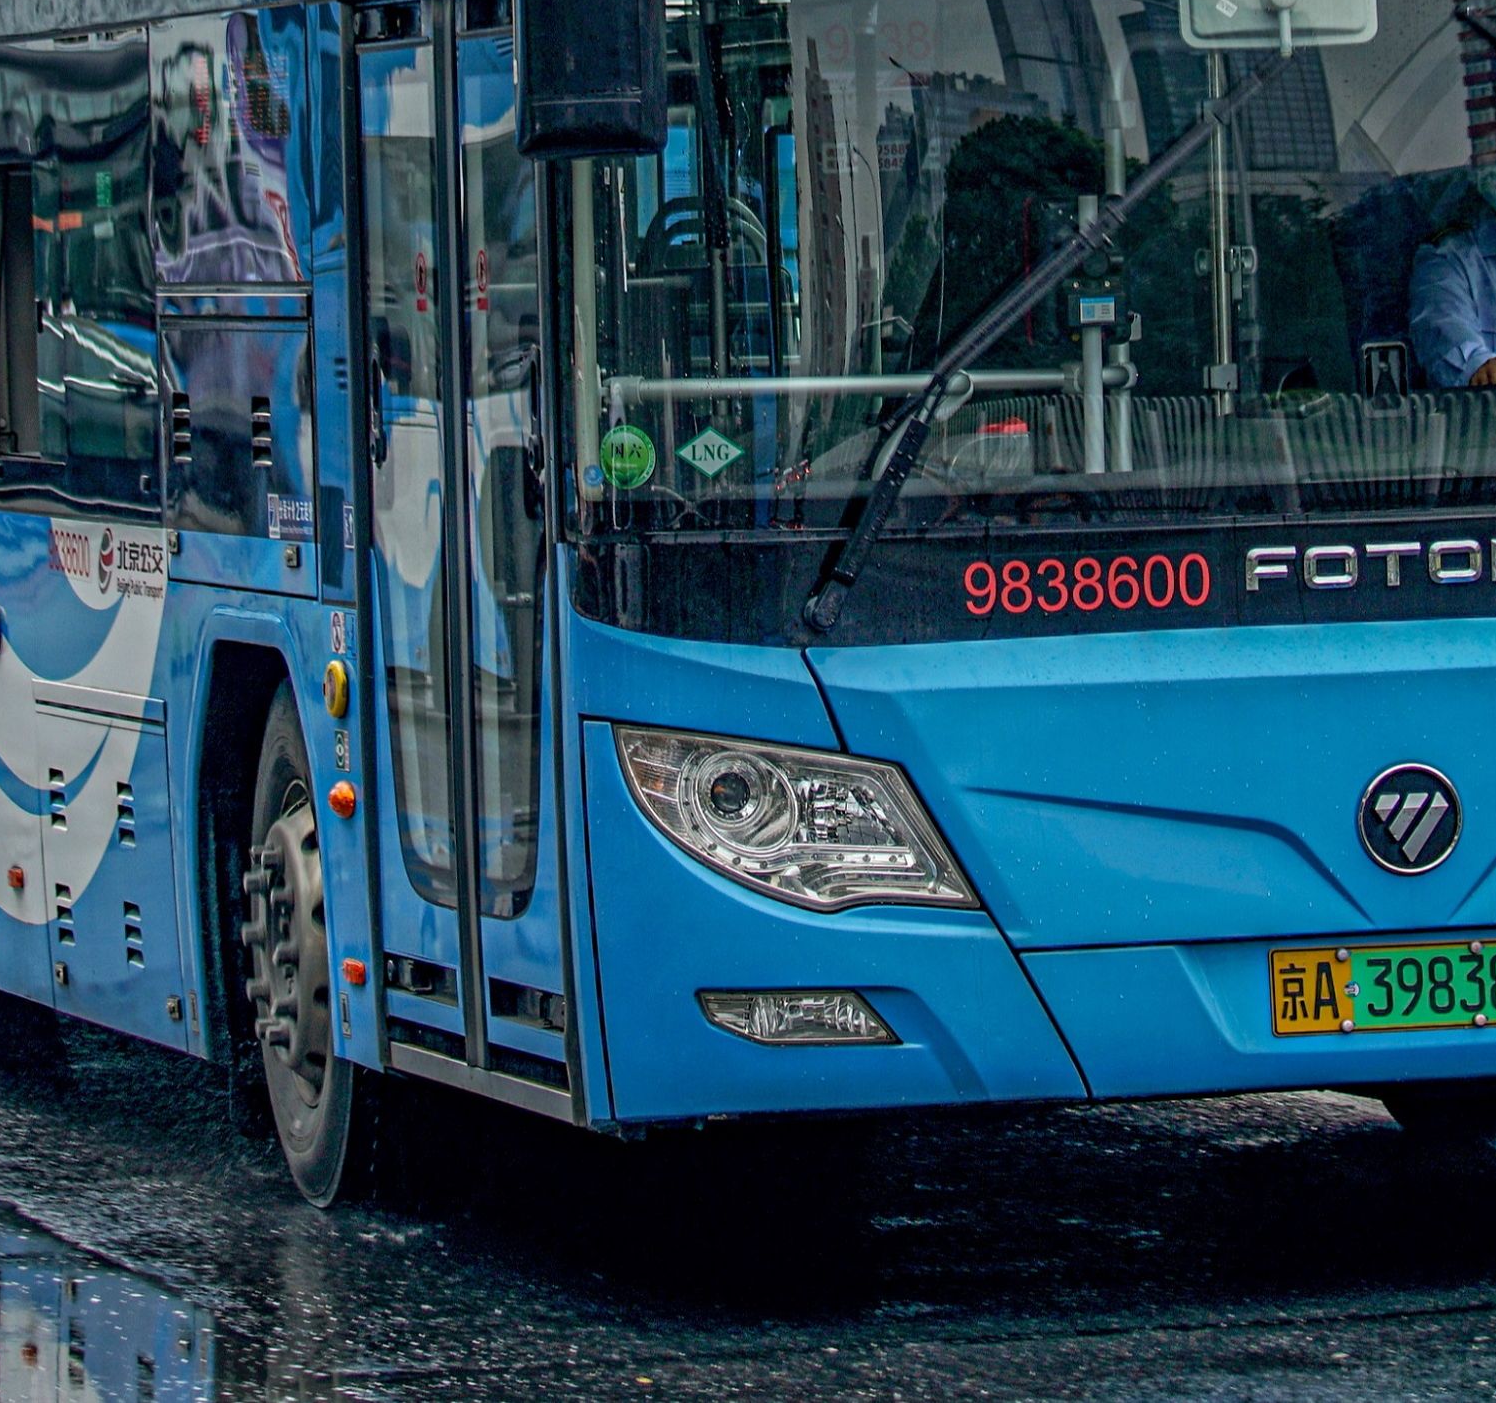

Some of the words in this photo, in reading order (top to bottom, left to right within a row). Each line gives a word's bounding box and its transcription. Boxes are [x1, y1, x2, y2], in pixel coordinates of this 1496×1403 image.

[691, 444, 730, 461] LNG
[117, 540, 164, 575] 北京公交
[964, 553, 1210, 615] 9838600
[1278, 962, 1339, 1020] 京A
